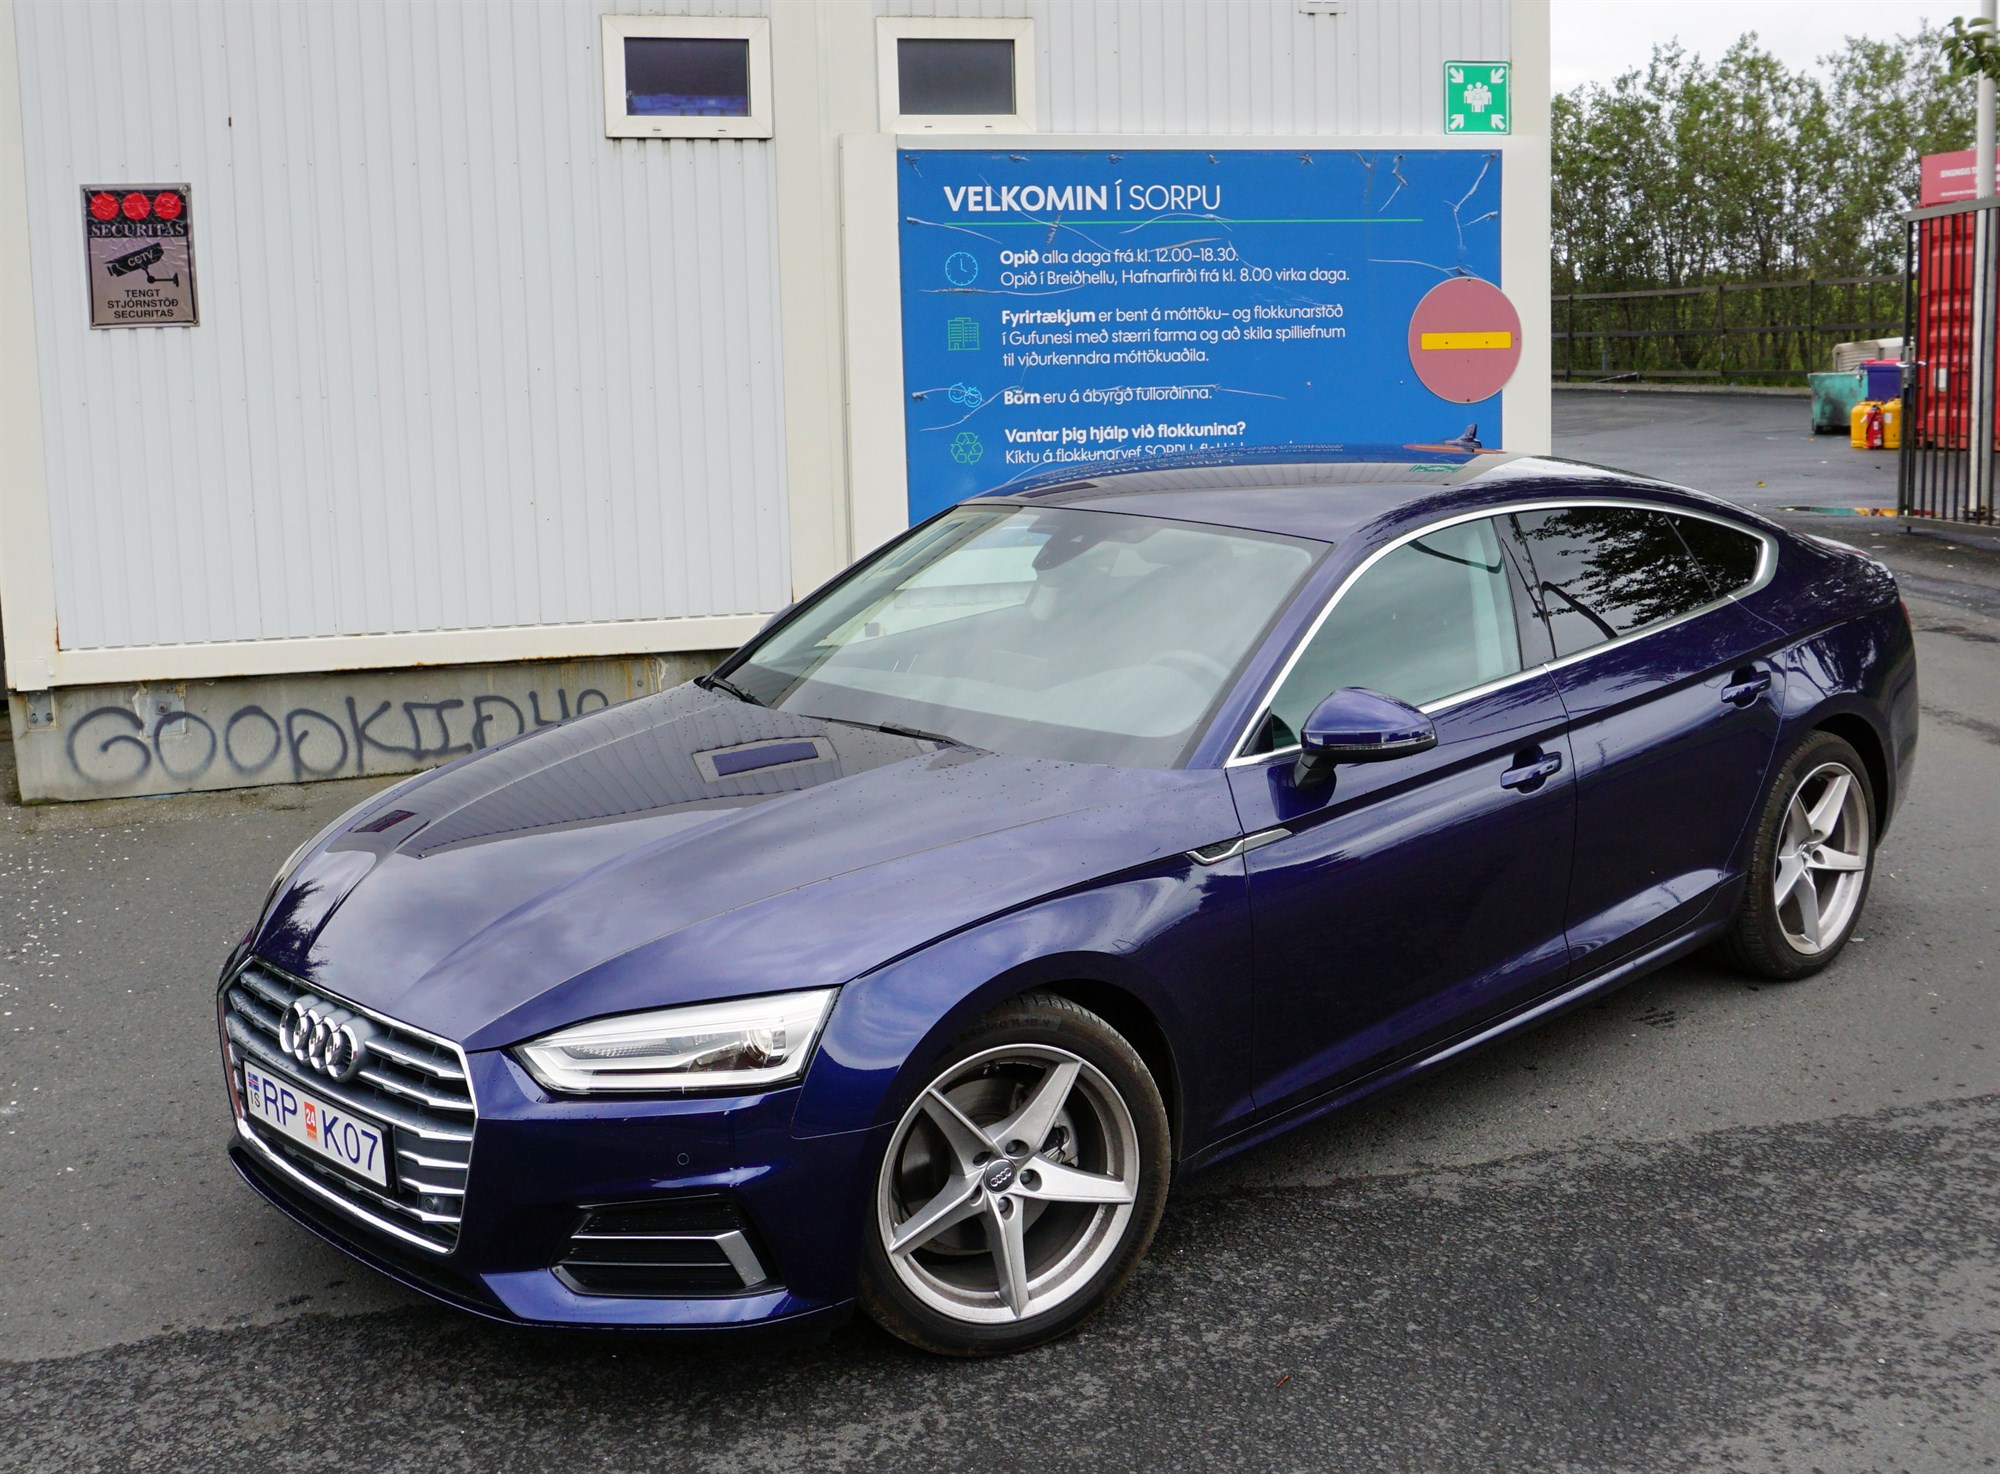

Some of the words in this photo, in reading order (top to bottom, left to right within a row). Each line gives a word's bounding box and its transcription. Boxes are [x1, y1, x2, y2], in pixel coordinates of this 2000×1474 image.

[944, 185, 1107, 212] VELKOMIN
[1114, 179, 1123, 210] Í
[1129, 185, 1221, 211] SORPU
[92, 223, 184, 237] SECURITAS
[127, 250, 154, 267] CCTV
[1000, 250, 1039, 268] Opið
[1042, 250, 1068, 264] alla
[1071, 249, 1111, 266] daga
[1114, 248, 1134, 263] frá
[1137, 248, 1151, 262] kl.
[1000, 271, 1037, 289] Opið
[1040, 271, 1044, 284] í
[1047, 269, 1118, 286] Breiðhellu,
[1121, 267, 1197, 284] Hafnarfirði
[1200, 268, 1219, 283] frá
[1222, 267, 1237, 282] kl.
[1240, 267, 1273, 281] 8.00
[1275, 268, 1306, 281] virka
[1309, 267, 1350, 284] daga.
[107, 298, 179, 309] STJÓRNSTÖÐ
[125, 289, 160, 298] TENGT
[113, 309, 175, 319] SECURITAS
[1001, 308, 1096, 327] Fyrirtækjum
[1098, 311, 1113, 322] er
[1116, 307, 1148, 322] bent
[1151, 307, 1161, 321] á
[1232, 307, 1251, 323] og
[1254, 303, 1344, 319] flokkunarstöð
[1002, 331, 1006, 345] í
[1009, 330, 1073, 346] Gufunesi
[1076, 328, 1109, 343] með
[1112, 328, 1151, 343] stærri
[1153, 327, 1197, 343] farma
[1200, 328, 1218, 344] og
[1221, 326, 1241, 340] að
[1244, 325, 1272, 340] skila
[1275, 324, 1346, 342] spilliefnum
[1003, 352, 1015, 366] til
[1018, 350, 1110, 367] viðurkenndra
[1113, 347, 1210, 364] móttökuaðila.
[1004, 389, 1040, 405] Börn
[1043, 393, 1066, 405] eru
[1069, 389, 1079, 403] á
[1082, 386, 1133, 406] ábyrgð
[1136, 385, 1212, 401] fullorðinna.
[1004, 428, 1059, 443] Vantar
[1062, 426, 1087, 445] þig
[1090, 424, 1129, 443] hjálp
[1132, 423, 1155, 438] við
[1158, 420, 1246, 438] flokkunina?
[1005, 448, 1040, 464] Kíktu
[1043, 448, 1053, 463] á
[1056, 445, 1142, 463] flokkunarvef
[249, 1091, 260, 1108] IS
[262, 1077, 298, 1127] RP
[305, 1108, 316, 1127] 24
